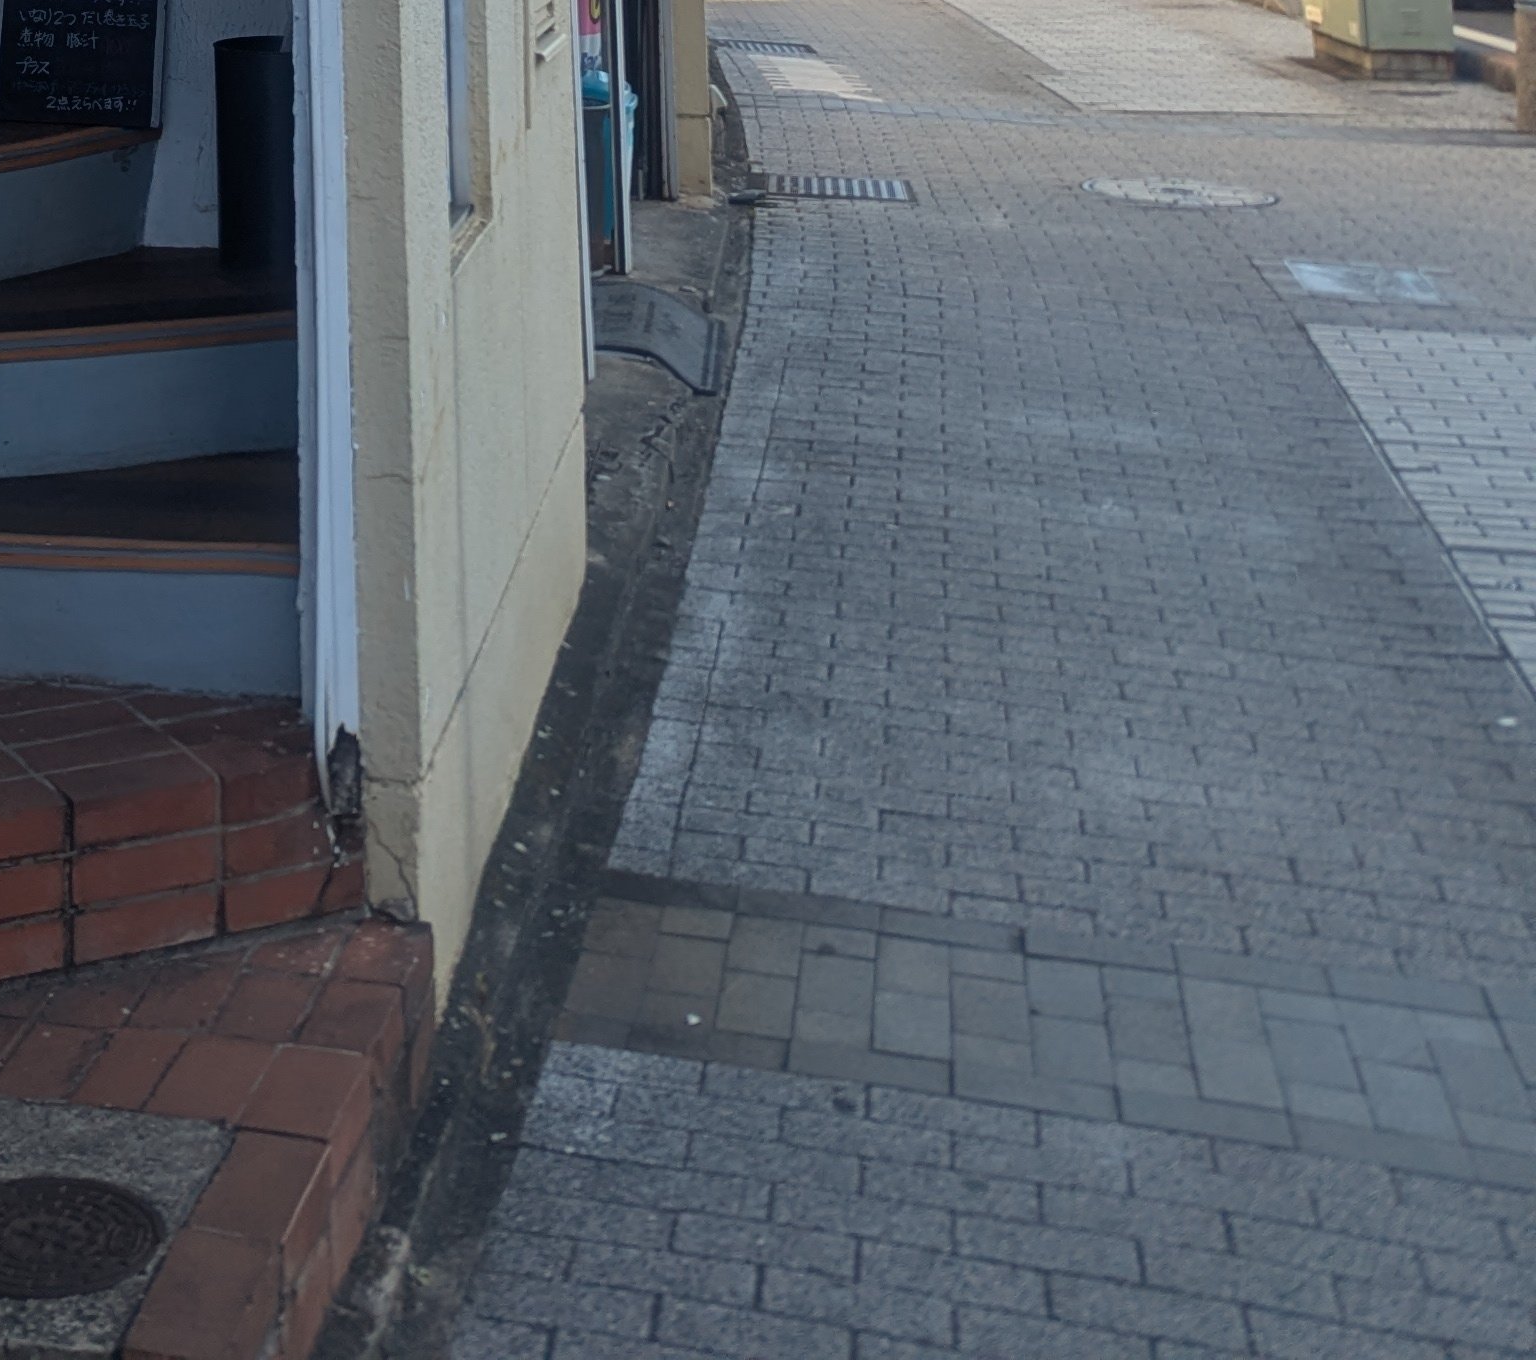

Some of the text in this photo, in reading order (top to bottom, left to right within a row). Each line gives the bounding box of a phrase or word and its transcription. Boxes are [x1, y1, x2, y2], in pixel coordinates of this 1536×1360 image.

[16, 26, 56, 49] 煮物
[15, 55, 50, 75] プラス
